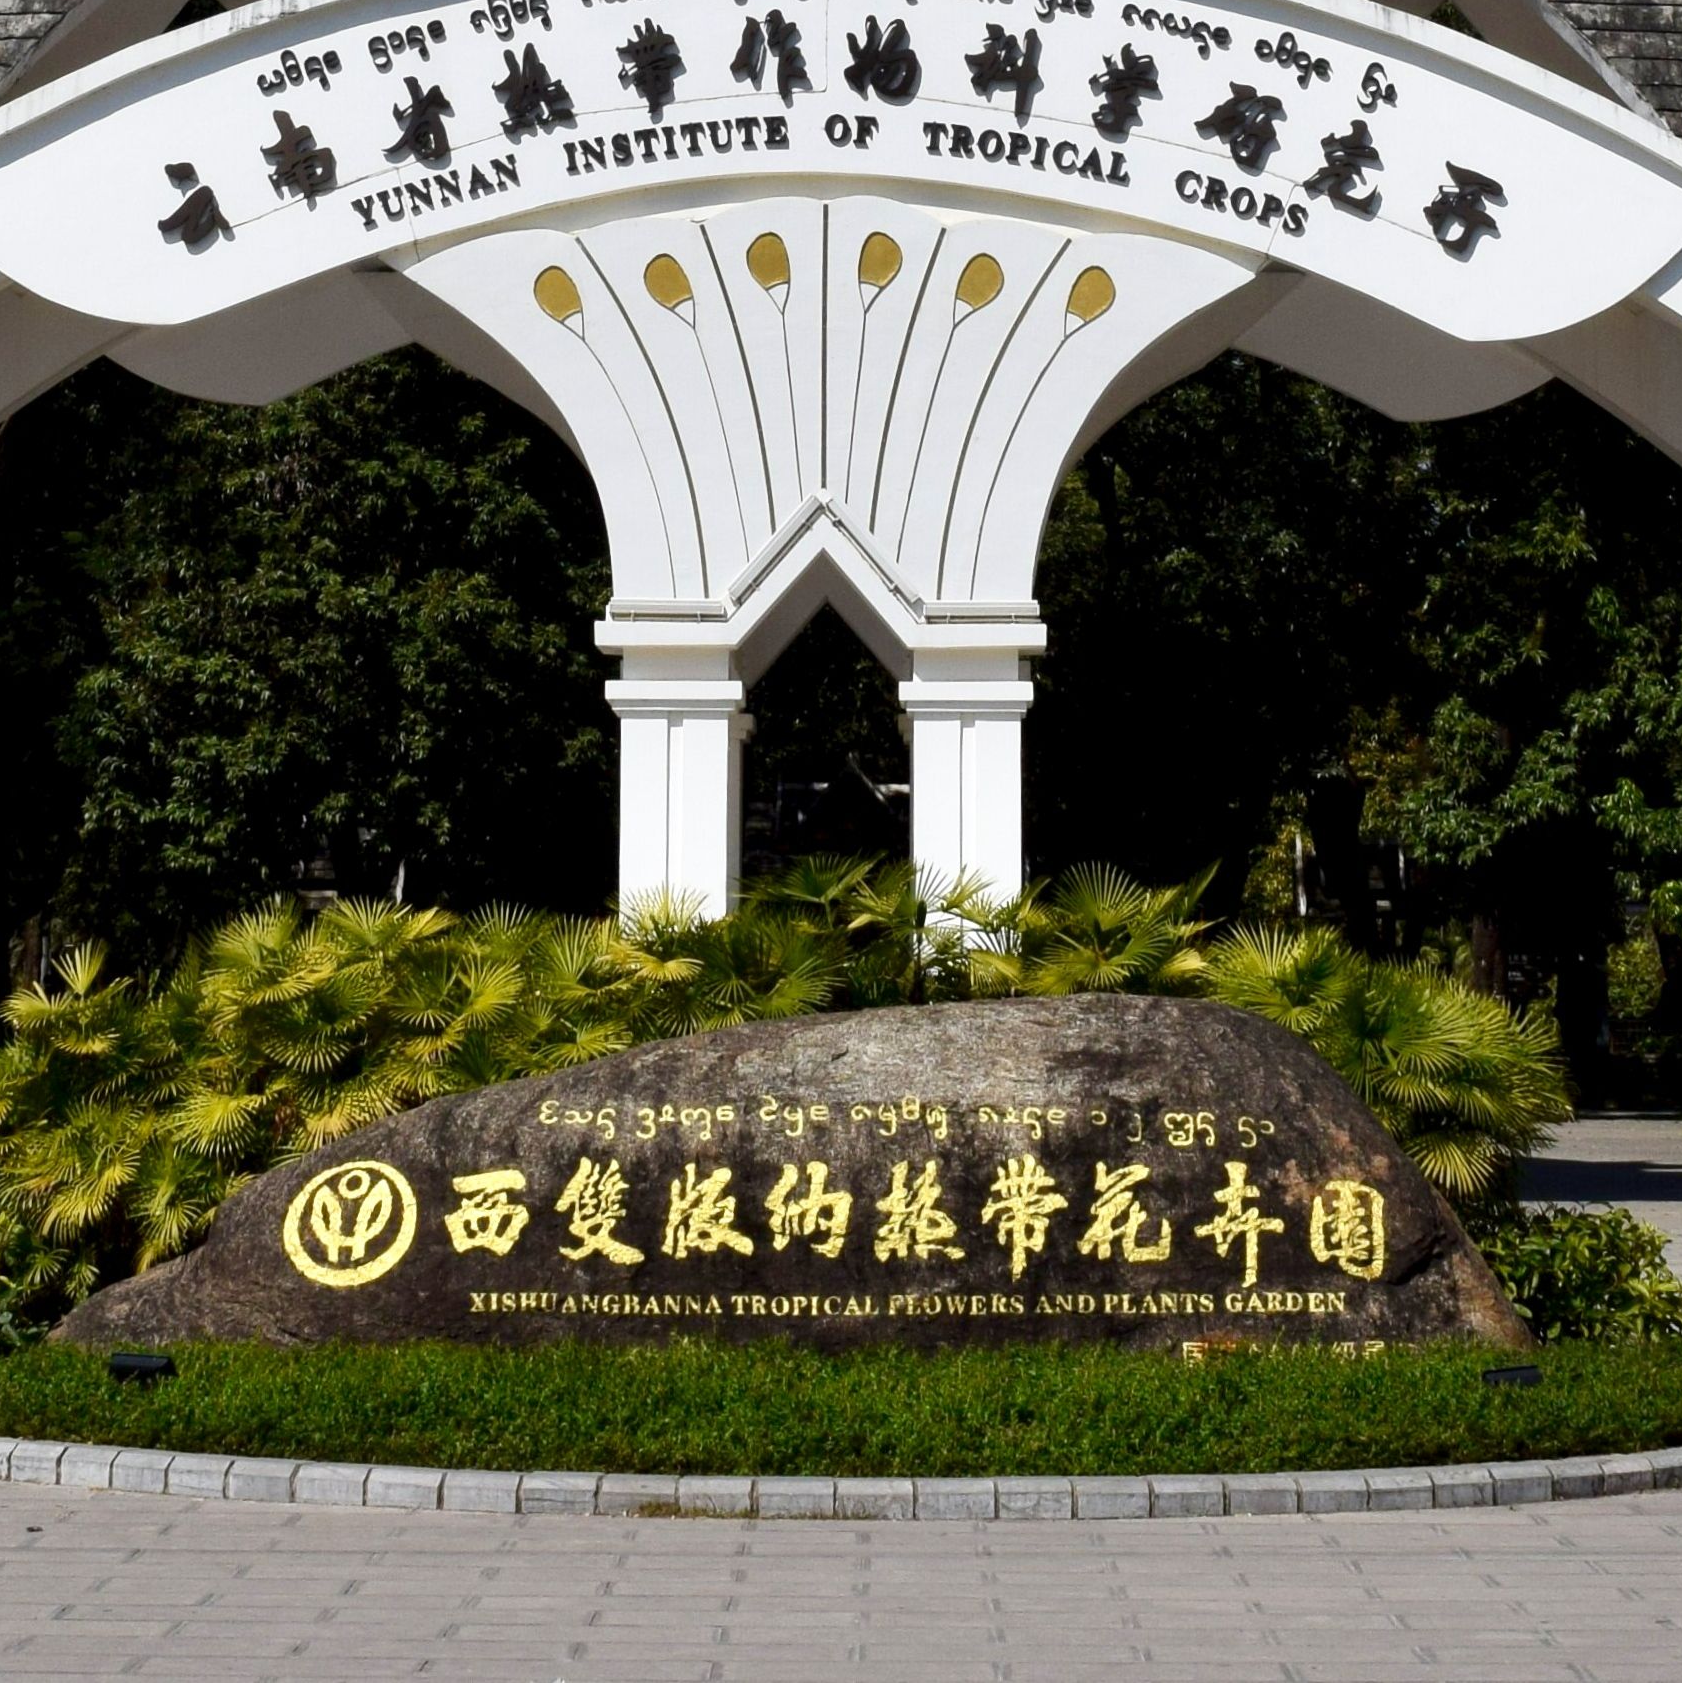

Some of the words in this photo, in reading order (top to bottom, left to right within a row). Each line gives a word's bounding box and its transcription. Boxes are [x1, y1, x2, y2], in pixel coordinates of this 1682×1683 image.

[351, 154, 519, 229] YUNNAN
[564, 116, 790, 177] INSTITUTE
[825, 114, 881, 149] OF
[922, 121, 1130, 187] TROPICAL
[1174, 169, 1310, 237] CROPS
[468, 1291, 723, 1316] XISHUANGBANNA
[730, 1293, 880, 1316] TROPICAL
[888, 1293, 1025, 1316] FLOWERS
[1035, 1293, 1097, 1315] AND
[1103, 1292, 1215, 1315] PLANTS
[1224, 1291, 1347, 1314] GARDEN
